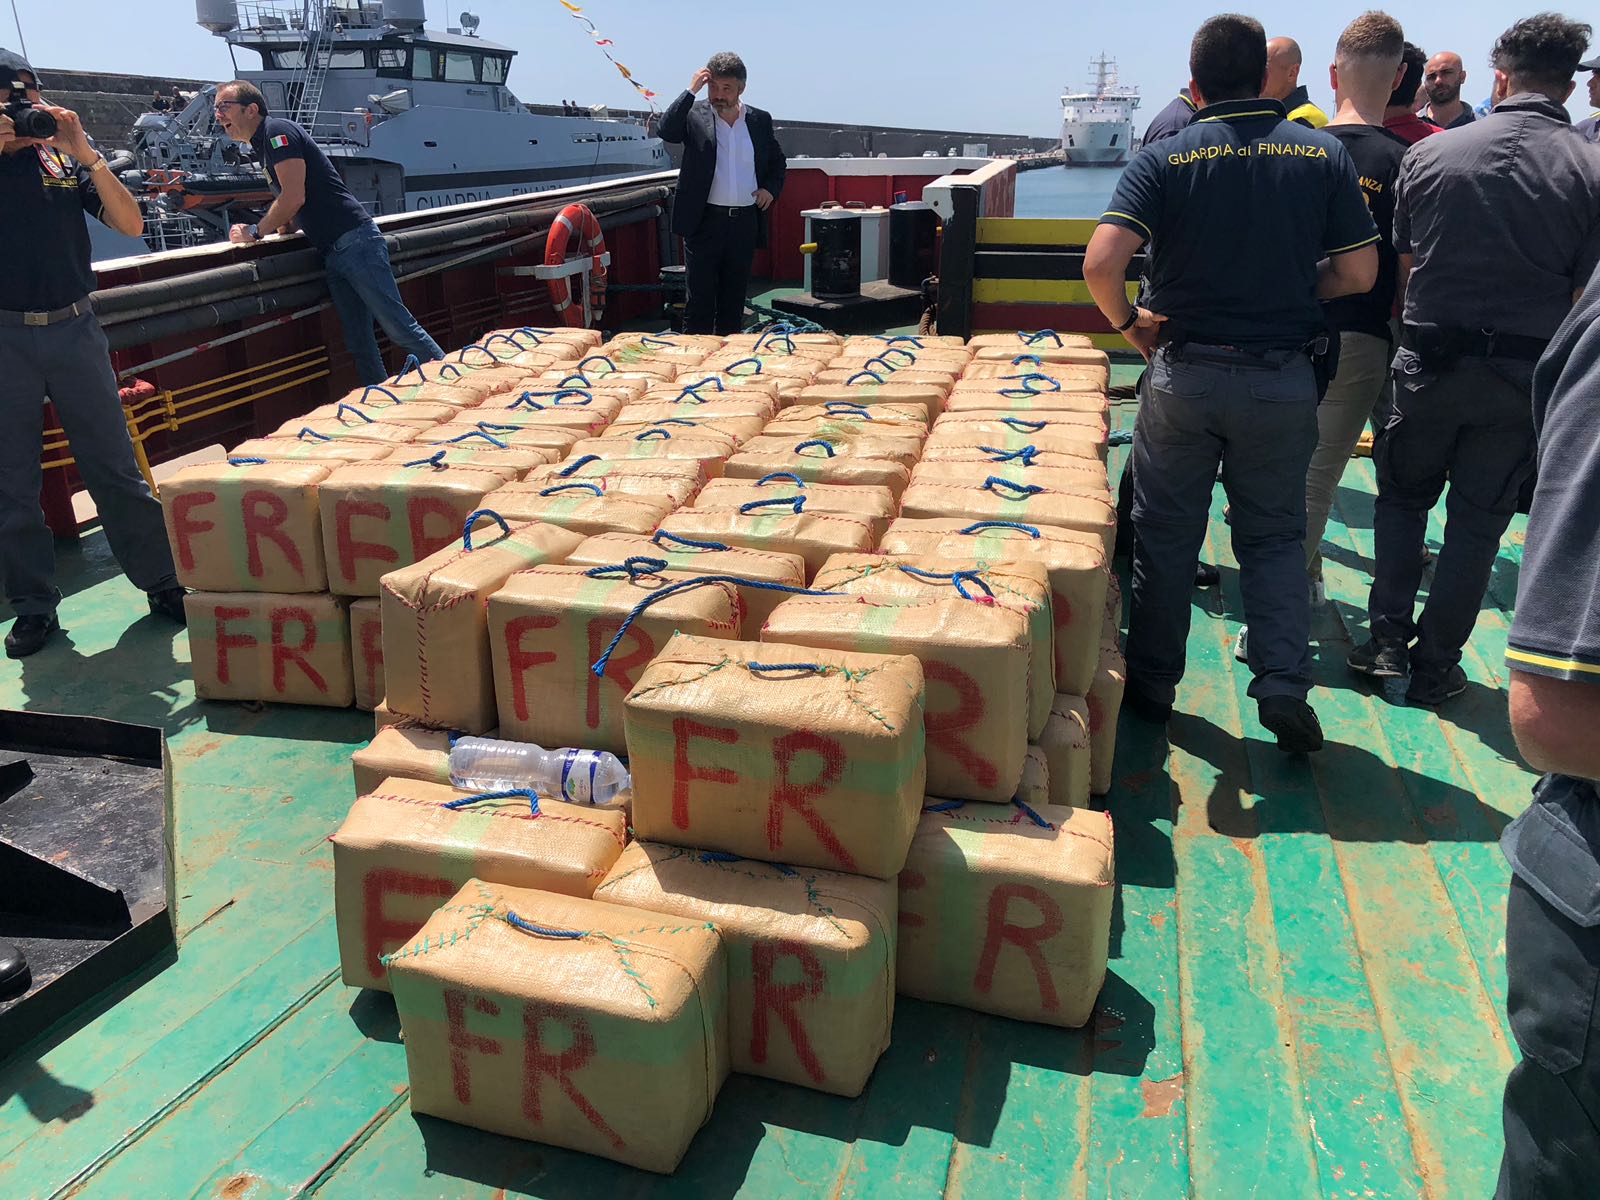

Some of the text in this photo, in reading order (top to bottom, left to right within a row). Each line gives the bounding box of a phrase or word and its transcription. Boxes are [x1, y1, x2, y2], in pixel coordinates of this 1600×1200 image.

[1168, 142, 1328, 166] GUARDIA di FINANZA
[172, 490, 305, 578] FR
[214, 606, 328, 693] FR
[504, 615, 654, 729] FR
[672, 717, 858, 872] FR
[750, 939, 827, 1084] R
[443, 988, 627, 1150] FR
